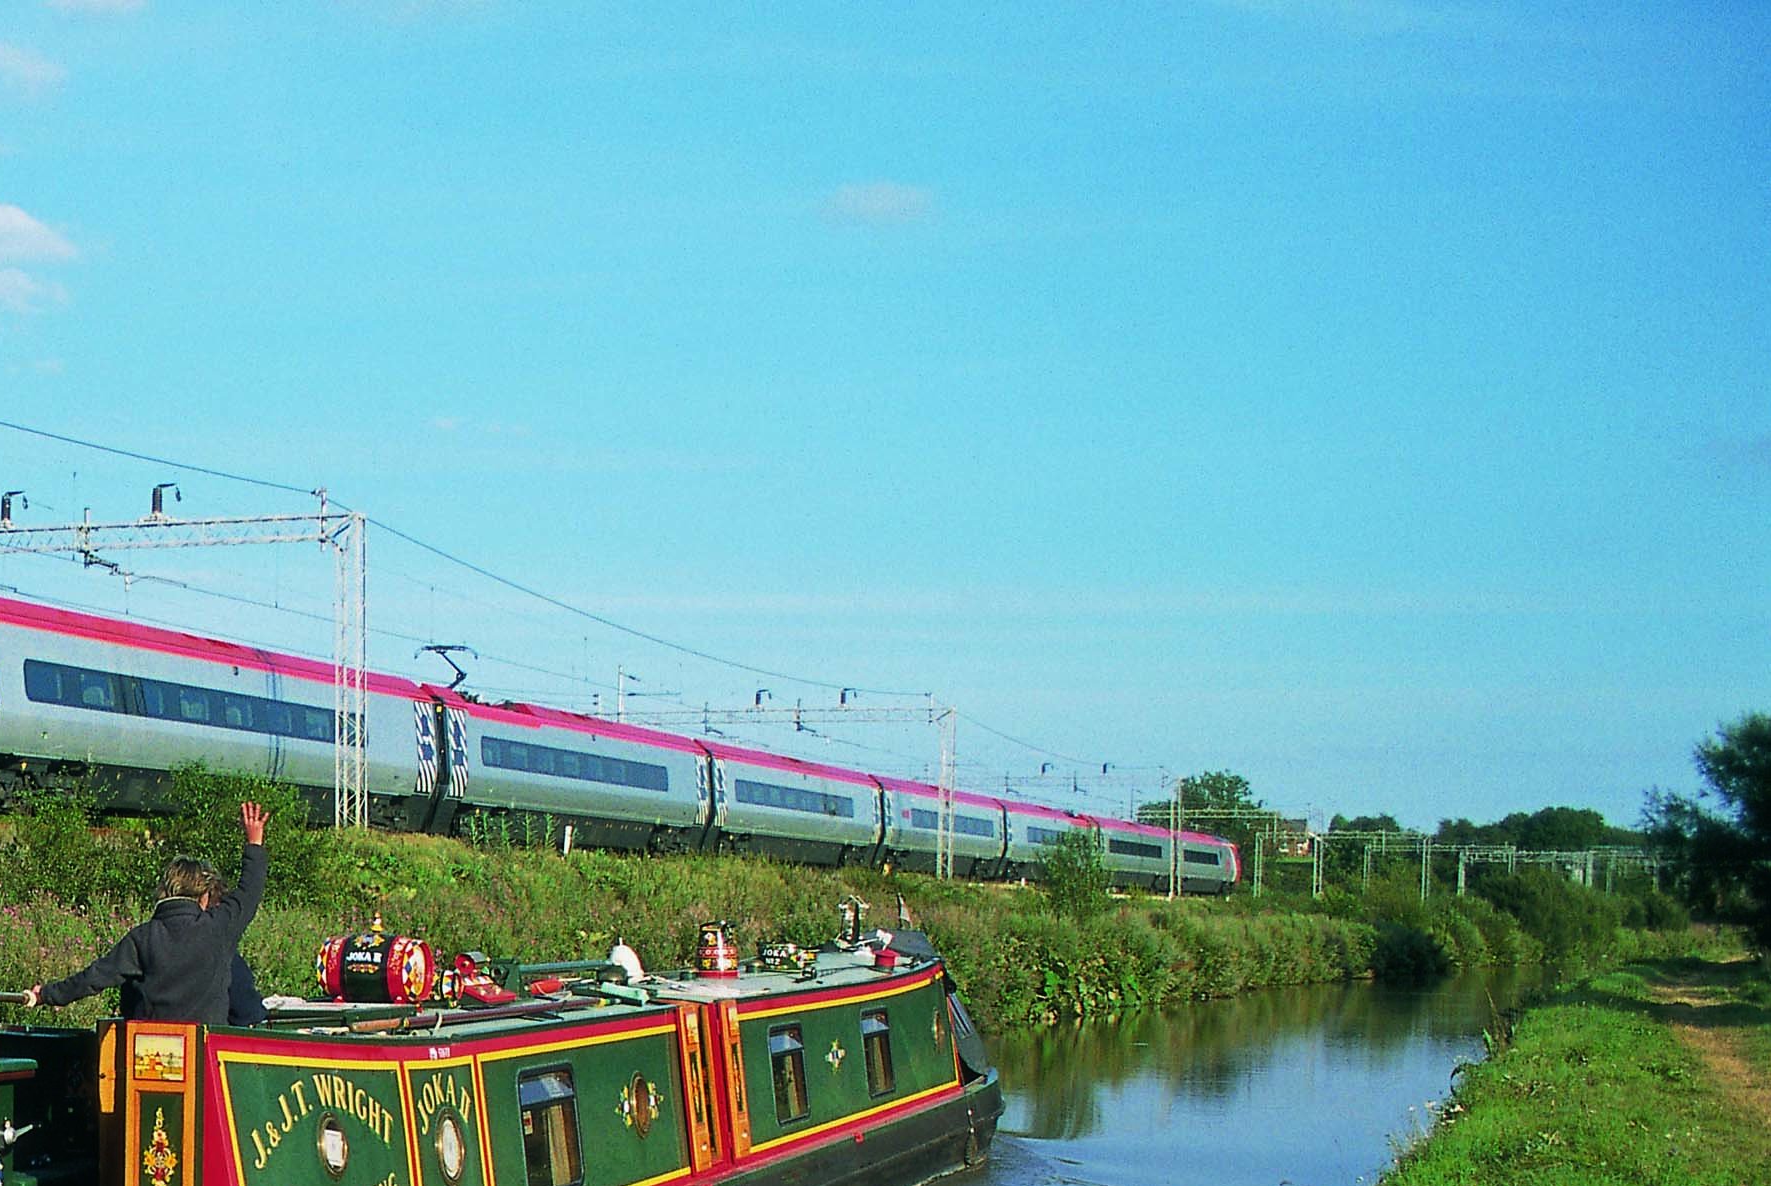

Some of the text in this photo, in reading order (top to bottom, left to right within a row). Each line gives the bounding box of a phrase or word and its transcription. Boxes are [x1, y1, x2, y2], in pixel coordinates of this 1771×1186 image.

[346, 951, 372, 962] JOKA
[762, 949, 788, 957] JOKA
[312, 1073, 394, 1145] WRIGHT
[417, 1072, 472, 1135] JOKA II
